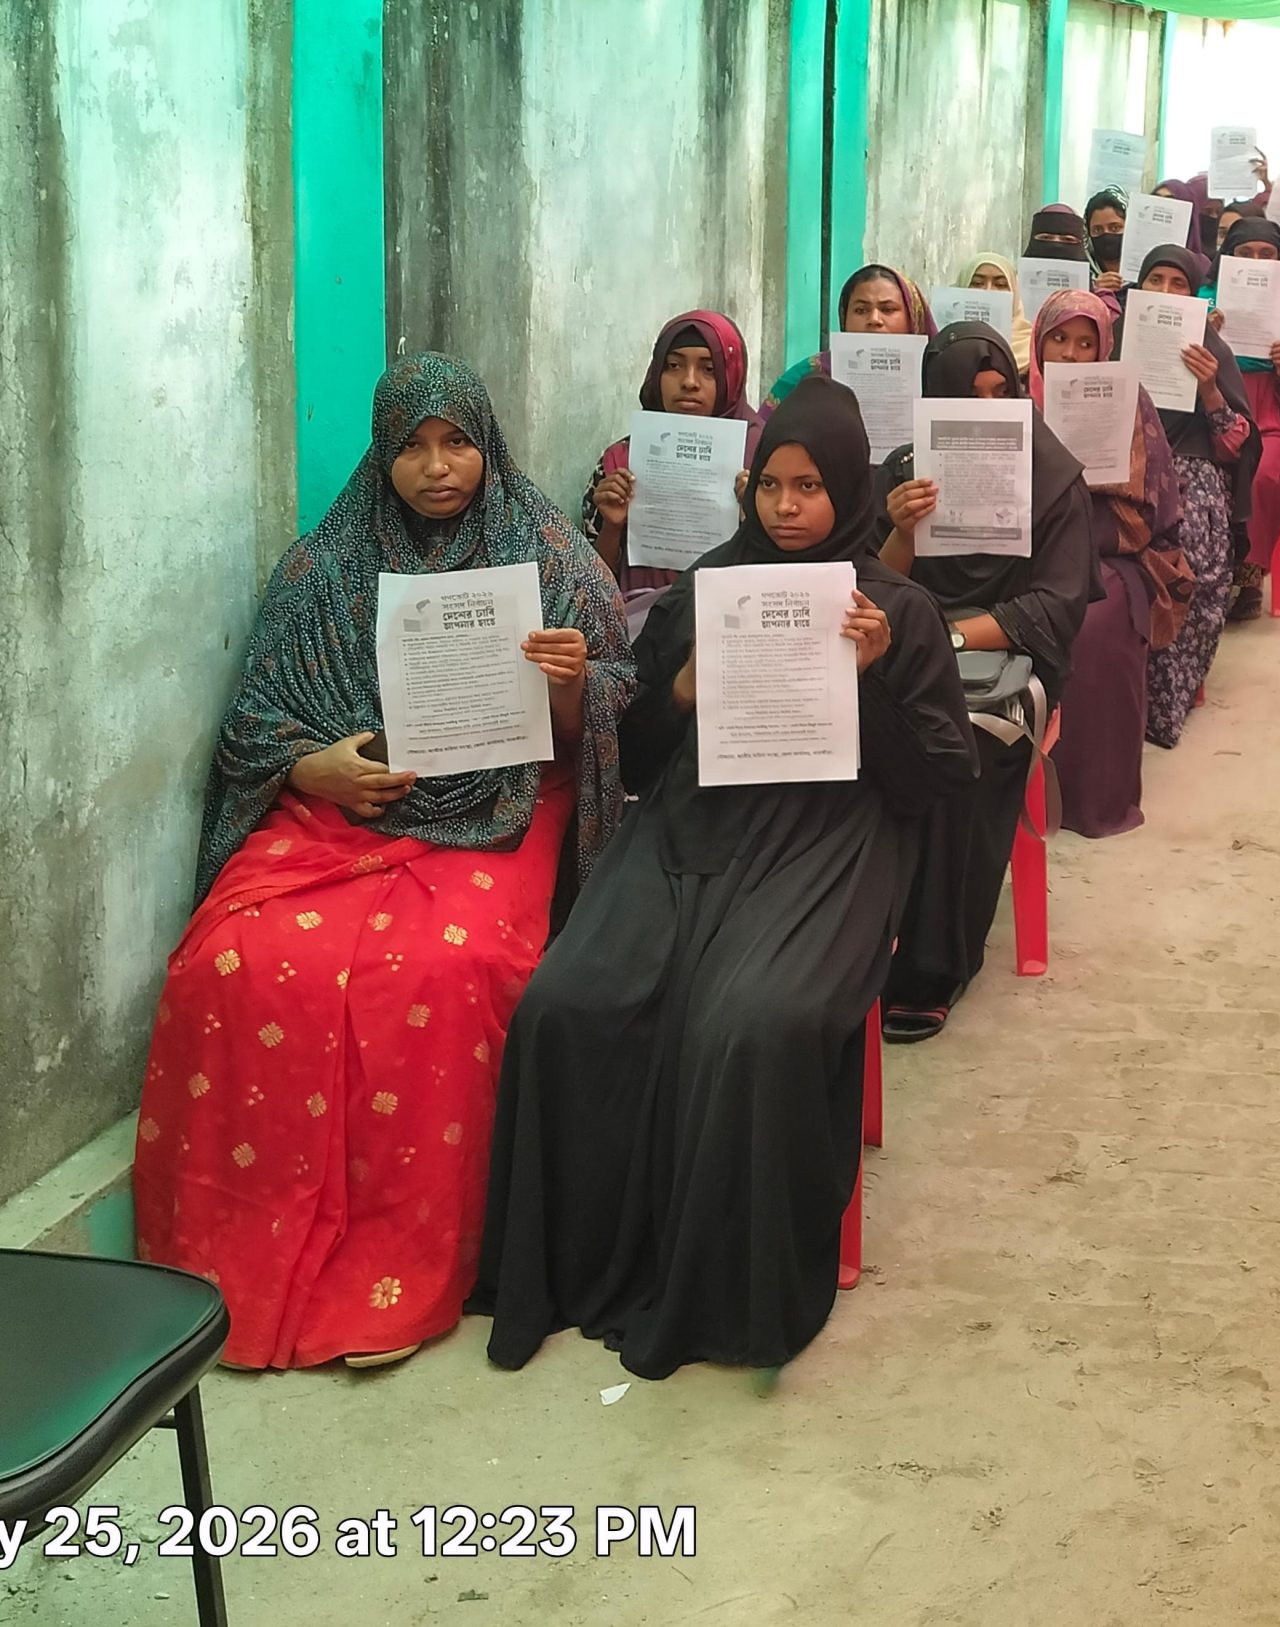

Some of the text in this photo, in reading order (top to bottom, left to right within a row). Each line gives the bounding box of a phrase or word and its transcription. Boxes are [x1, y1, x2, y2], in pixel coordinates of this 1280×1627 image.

[443, 605, 495, 621] দেশের চাবি
[761, 606, 810, 619] দেশের চাবি
[443, 620, 474, 630] আপনার
